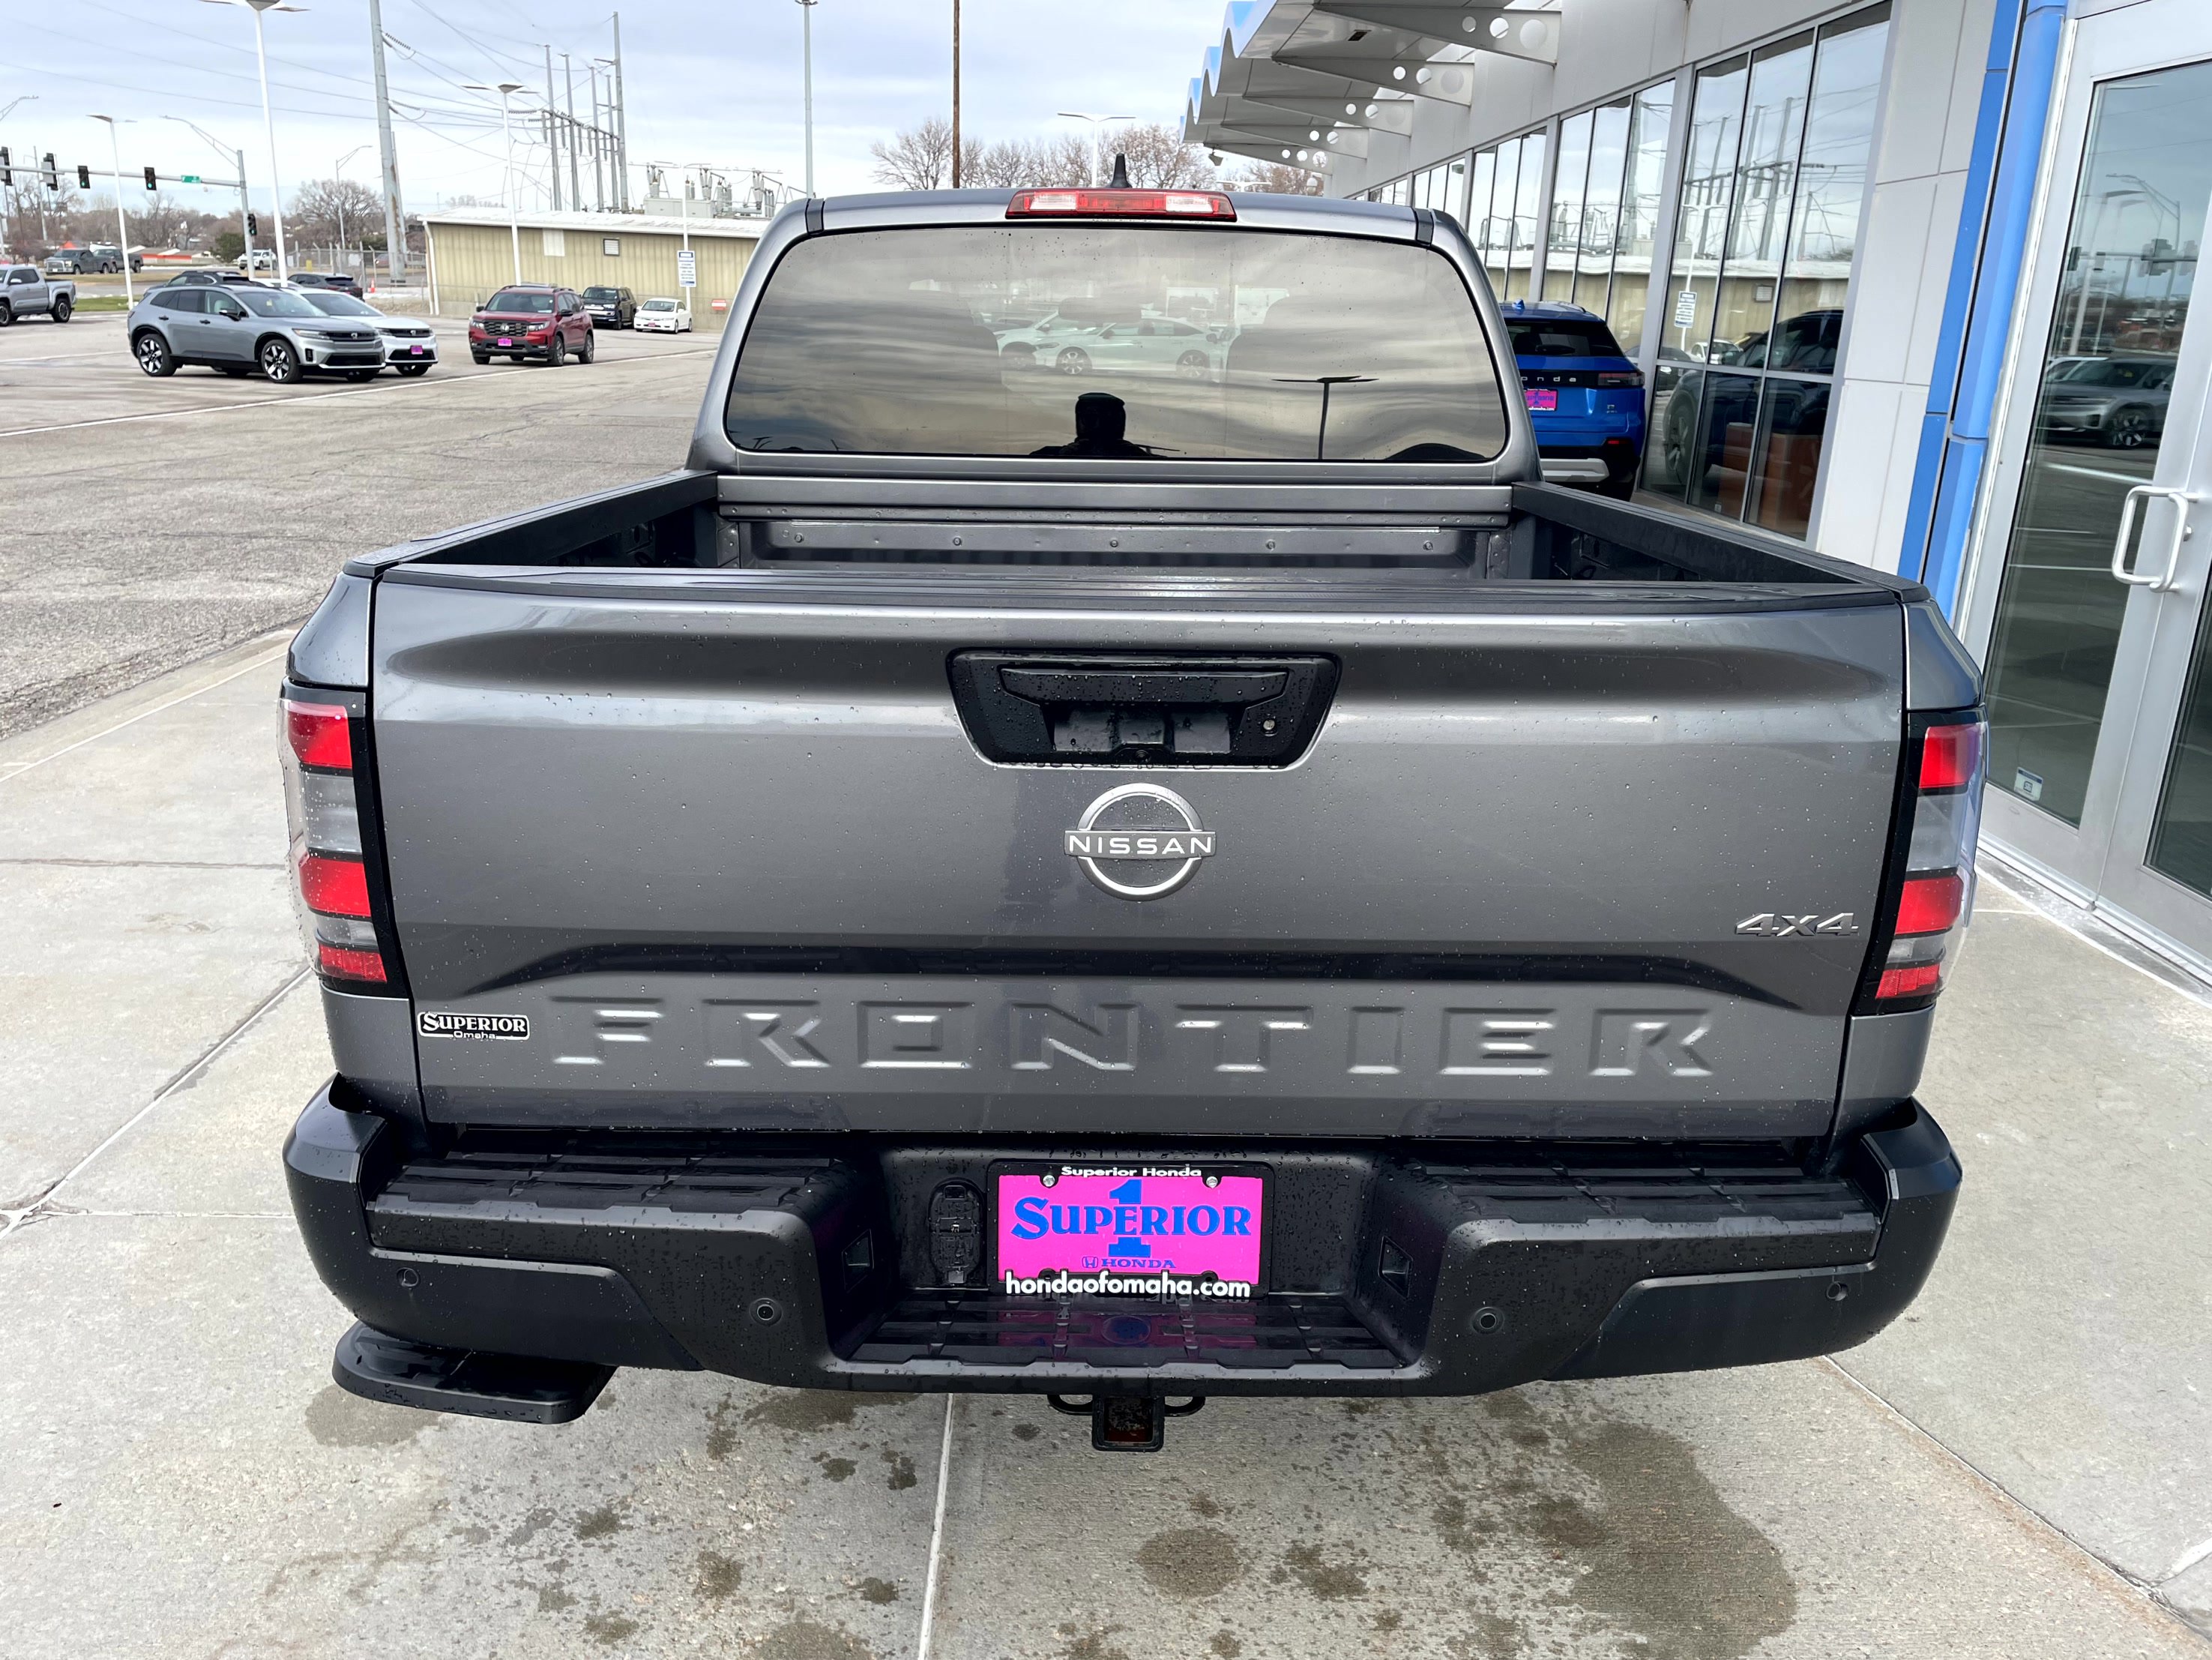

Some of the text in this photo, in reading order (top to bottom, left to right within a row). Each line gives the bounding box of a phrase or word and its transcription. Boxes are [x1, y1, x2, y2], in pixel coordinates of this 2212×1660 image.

[1069, 835, 1211, 855] NISSAN
[422, 1012, 526, 1032] SUPERIOR
[453, 1030, 496, 1039] Omaha
[548, 996, 1717, 1077] FRONTIER
[1061, 1167, 1202, 1177] Superior Honda
[1010, 1197, 1252, 1240] SUPERIOR
[1101, 1258, 1176, 1269] HONDA
[1006, 1270, 1250, 1298] hondaofomaha.com
